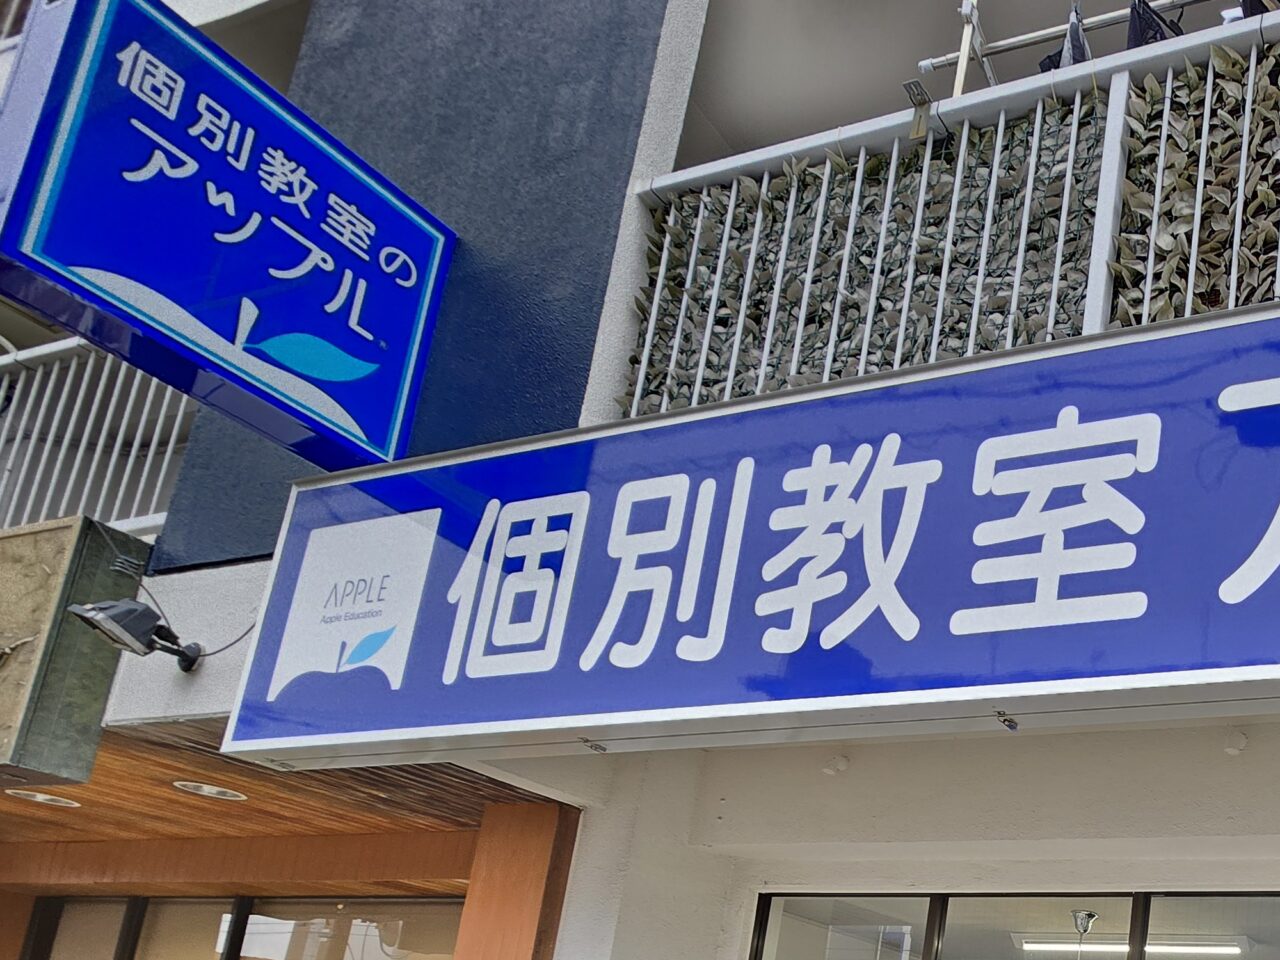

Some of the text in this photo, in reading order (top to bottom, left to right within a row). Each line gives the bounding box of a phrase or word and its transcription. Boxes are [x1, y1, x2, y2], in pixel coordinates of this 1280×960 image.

[116, 41, 417, 287] 個別教室の
[122, 118, 374, 341] アップル
[323, 574, 390, 609] APPLE
